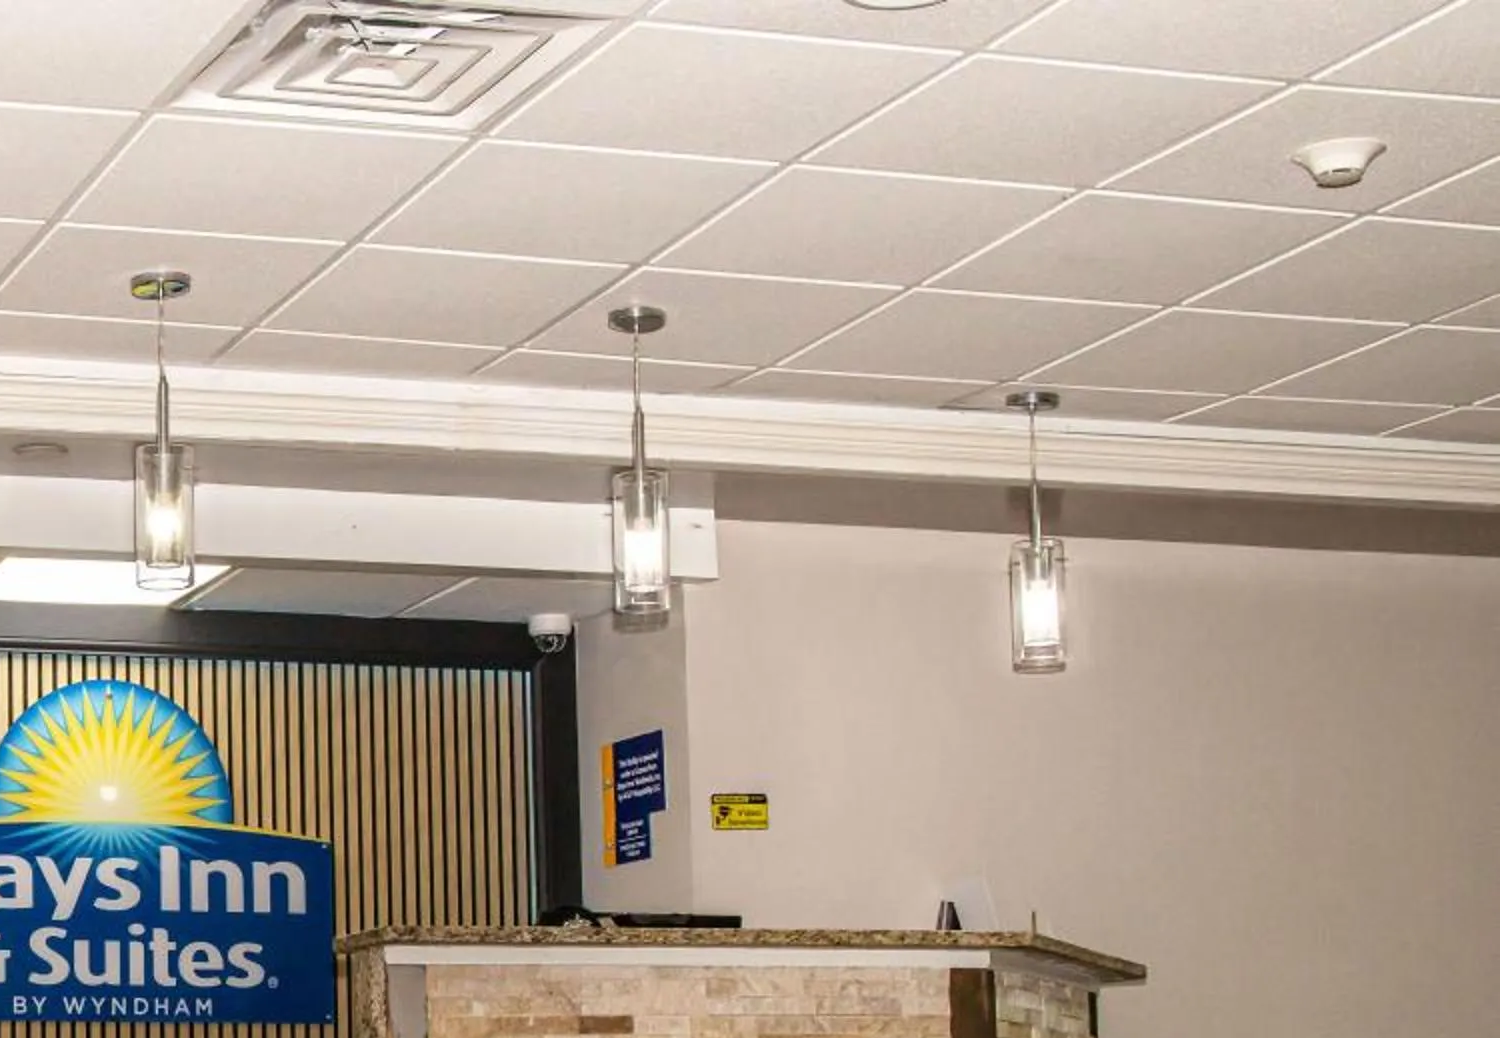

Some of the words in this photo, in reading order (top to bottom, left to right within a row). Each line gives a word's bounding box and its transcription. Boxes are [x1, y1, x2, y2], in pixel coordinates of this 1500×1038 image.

[159, 845, 307, 914] Inn
[12, 996, 48, 1015] BY
[63, 996, 214, 1016] WYNDHAM
